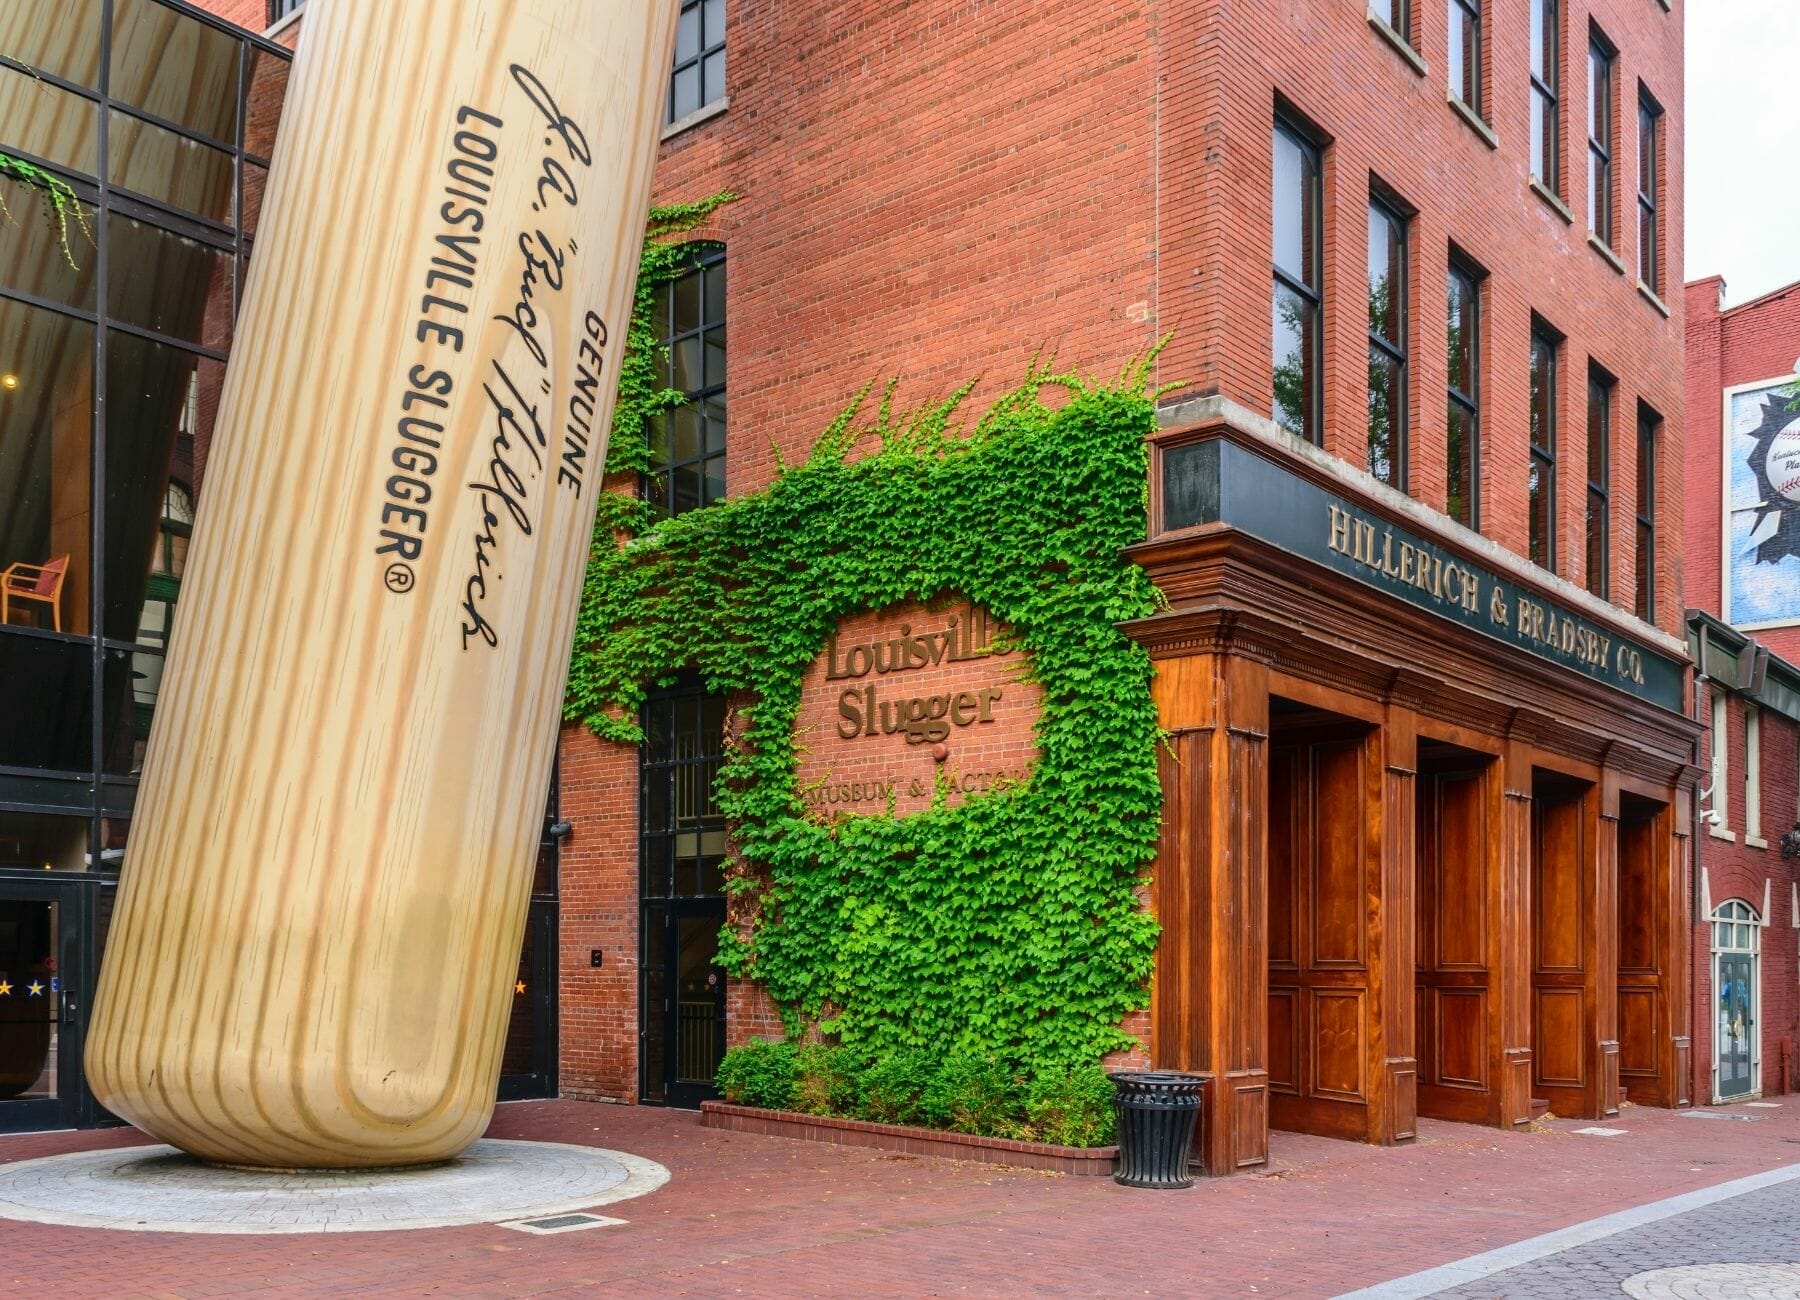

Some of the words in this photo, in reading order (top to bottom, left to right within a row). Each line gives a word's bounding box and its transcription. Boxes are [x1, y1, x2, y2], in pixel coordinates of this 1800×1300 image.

[416, 105, 503, 352] LOUISVILLE
[557, 310, 609, 500] GENUINE
[461, 358, 547, 651] Hillerich
[1327, 504, 1480, 614] HILLERICH
[1489, 586, 1509, 626] &
[1517, 597, 1610, 670] BRADSBY
[837, 684, 1002, 744] Slugger
[909, 778, 926, 798] &
[942, 768, 1033, 795] ACTO
